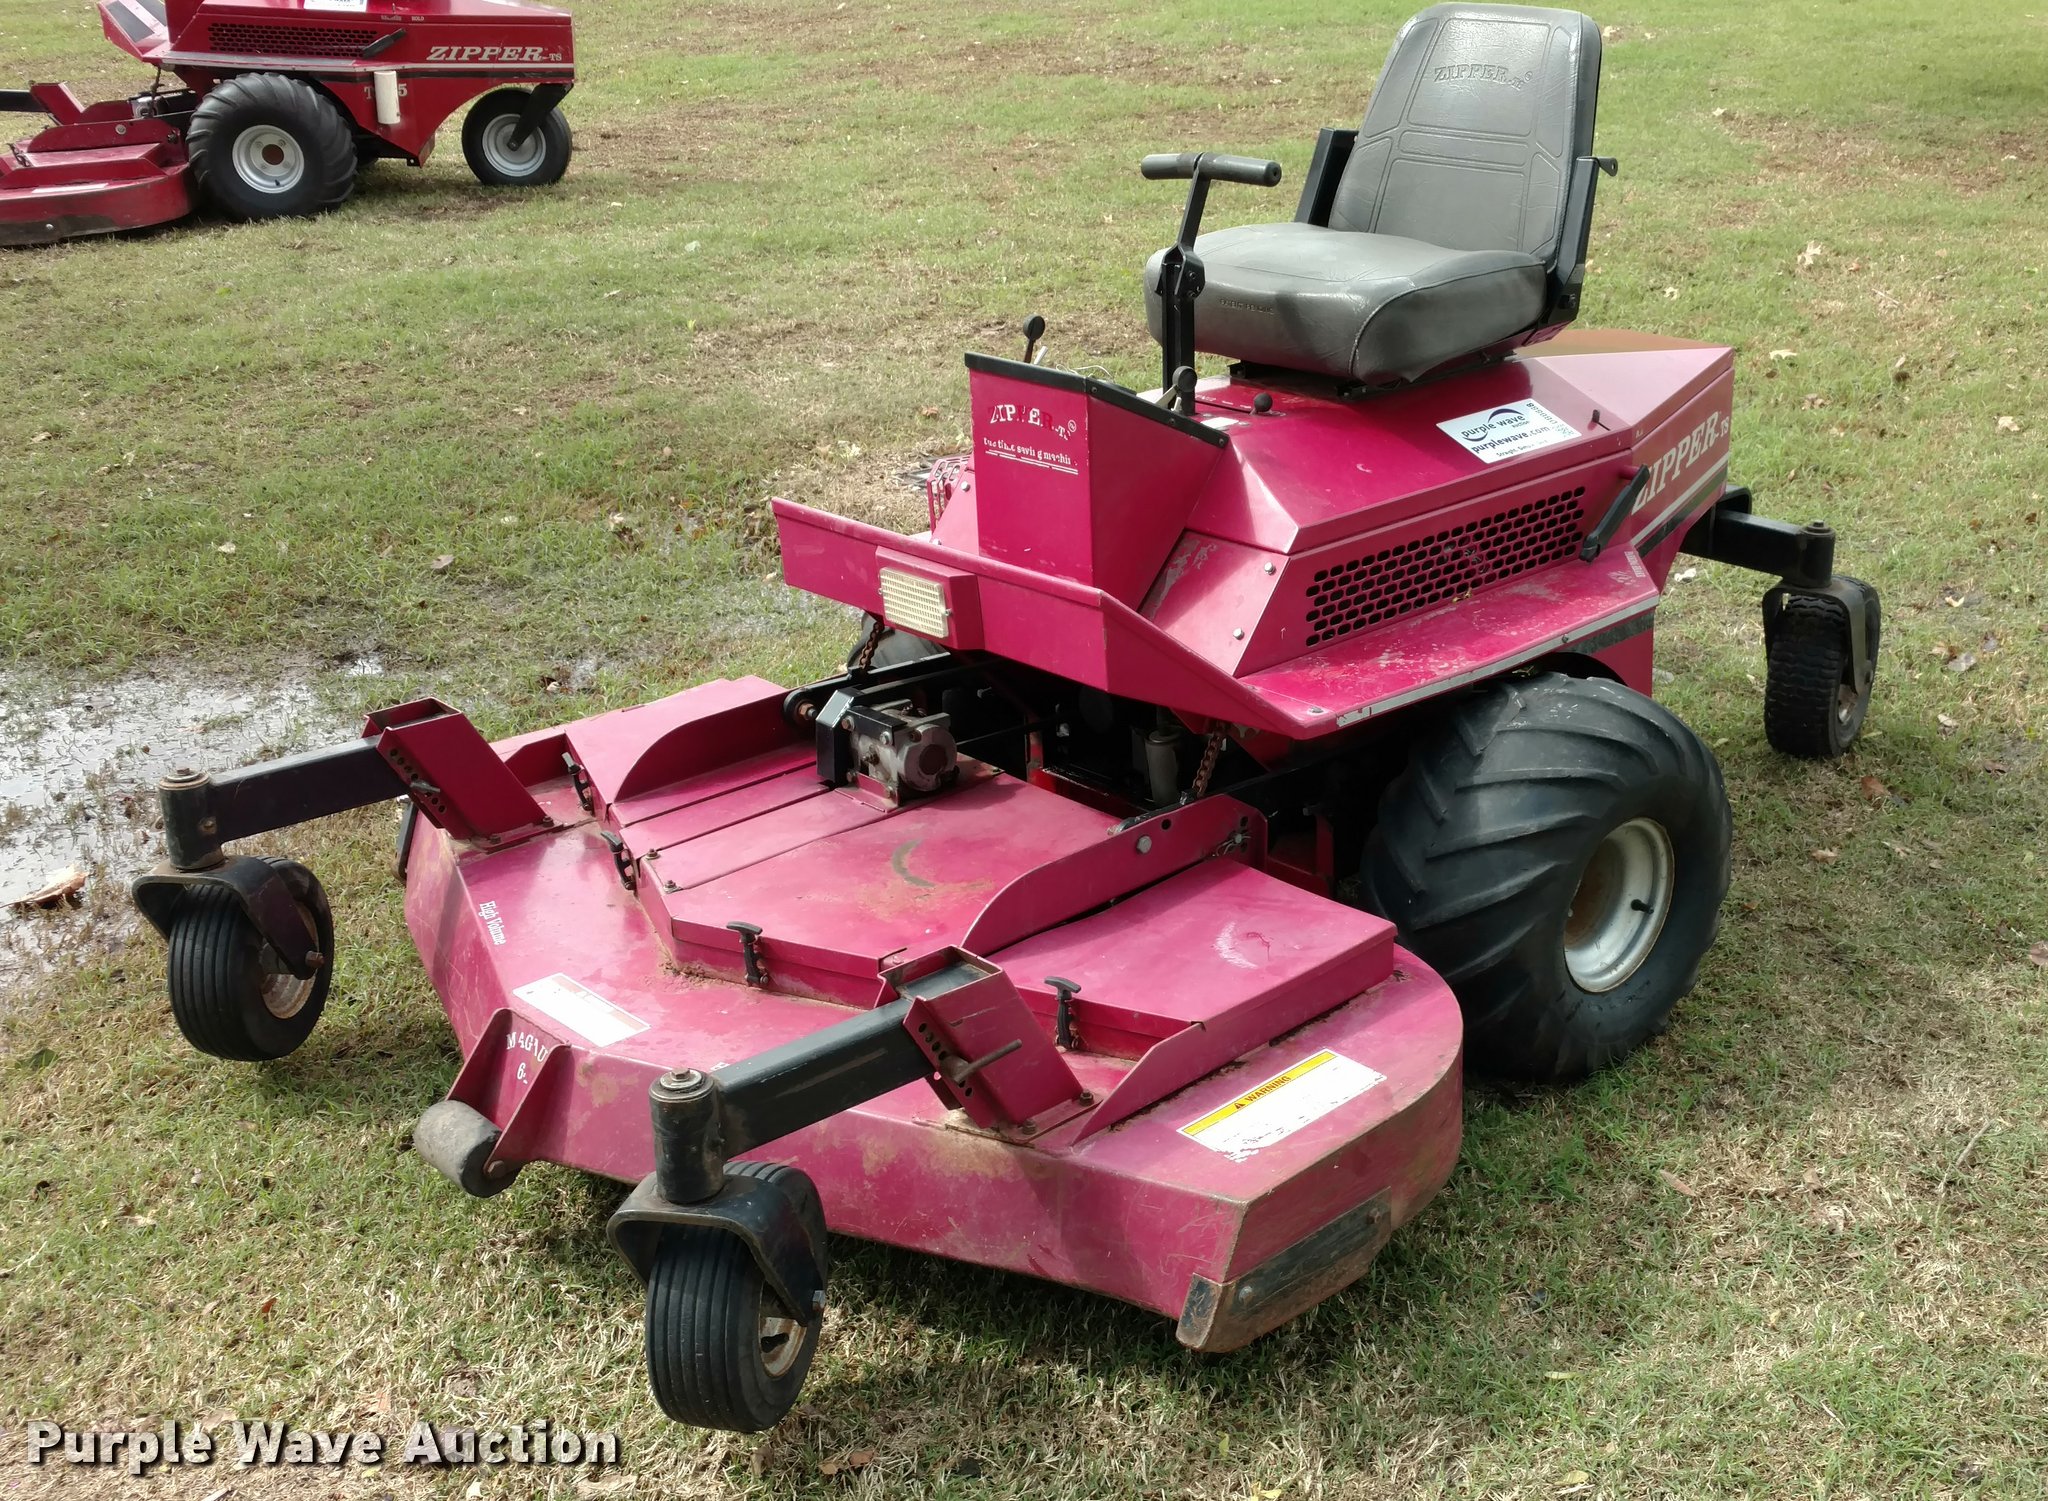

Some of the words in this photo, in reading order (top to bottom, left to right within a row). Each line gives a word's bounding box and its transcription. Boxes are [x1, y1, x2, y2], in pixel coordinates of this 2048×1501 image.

[1461, 422, 1497, 438] purple
[1496, 414, 1526, 427] wave
[1471, 425, 1550, 454] purplewave.com
[478, 900, 499, 920] High
[486, 917, 507, 946] Volume
[1244, 1075, 1292, 1102] WARNING
